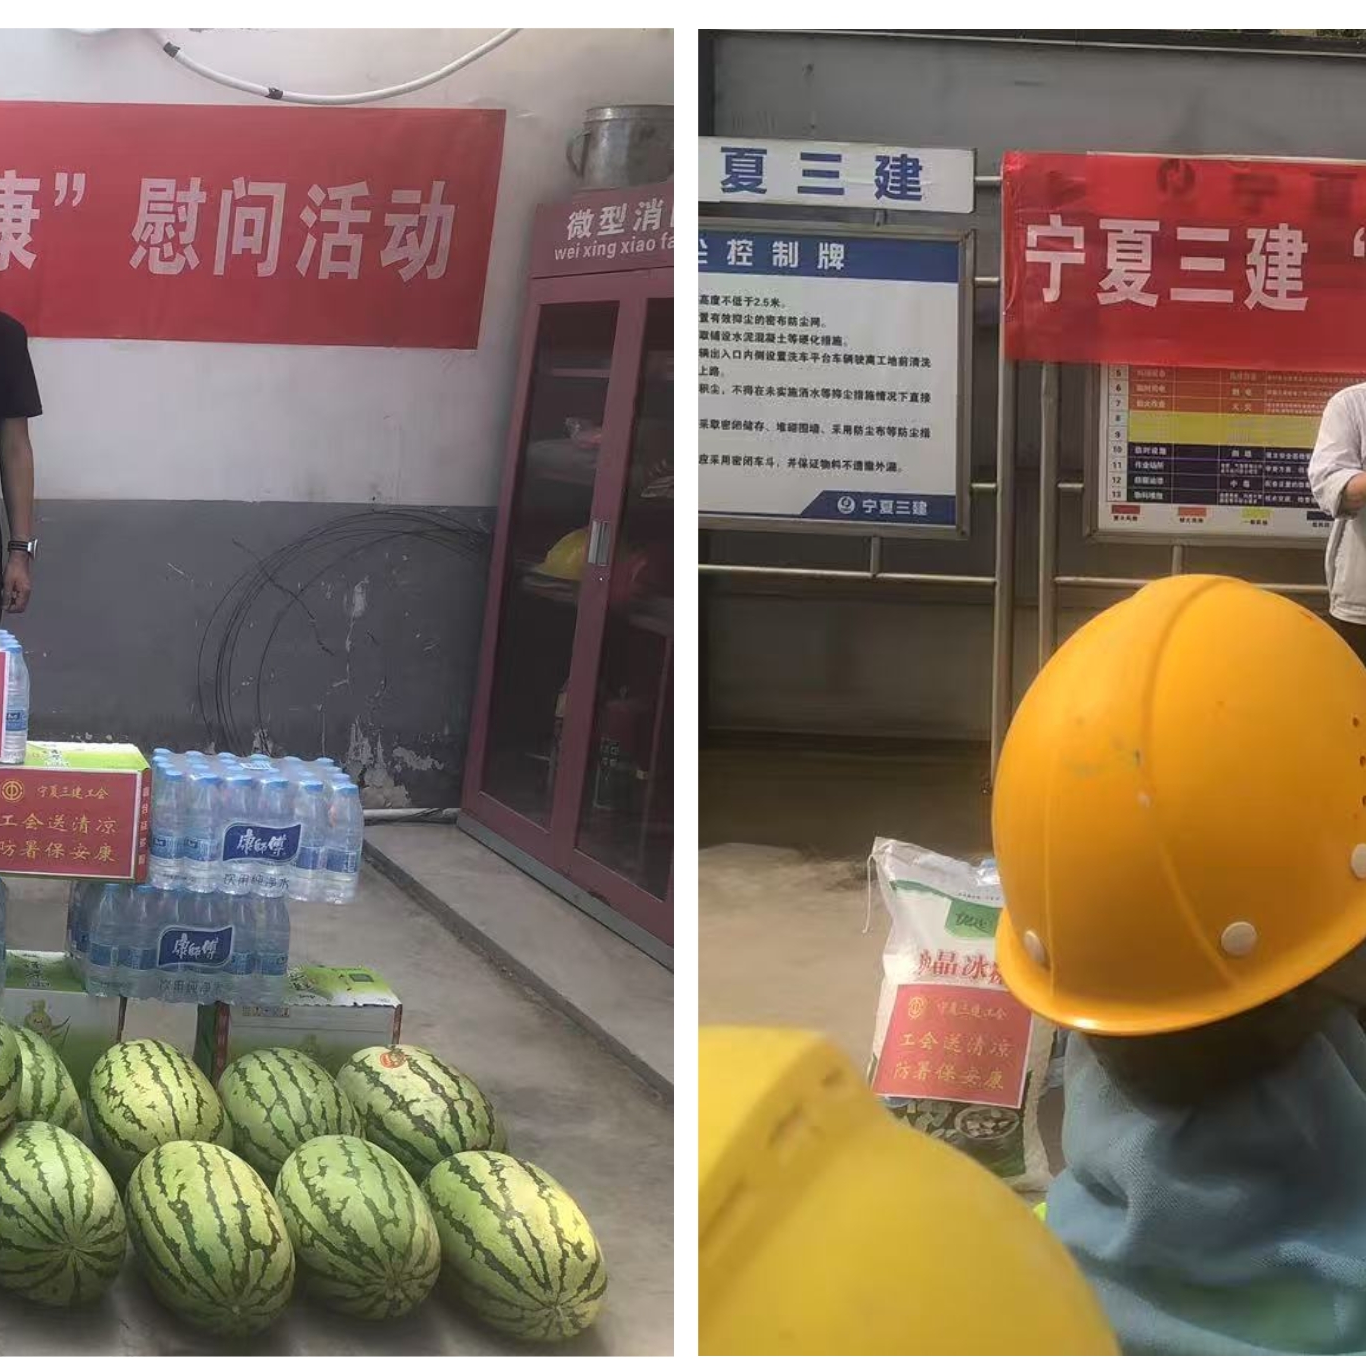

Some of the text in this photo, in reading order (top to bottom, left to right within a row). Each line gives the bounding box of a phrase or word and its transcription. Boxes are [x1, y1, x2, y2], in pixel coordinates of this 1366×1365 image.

[720, 146, 923, 202] 夏三建
[130, 177, 459, 281] 慰问活动
[567, 198, 674, 240] 微型消
[554, 243, 580, 260] wei
[583, 240, 617, 258] xing
[621, 236, 656, 254] xiao
[1026, 213, 1309, 312] 宁夏三建
[862, 499, 928, 516] 宁夏三建
[36, 782, 110, 801] 宁夏三建工会
[899, 1031, 1013, 1057] 工会送清凉
[893, 1060, 1005, 1091] 防暑保安康
